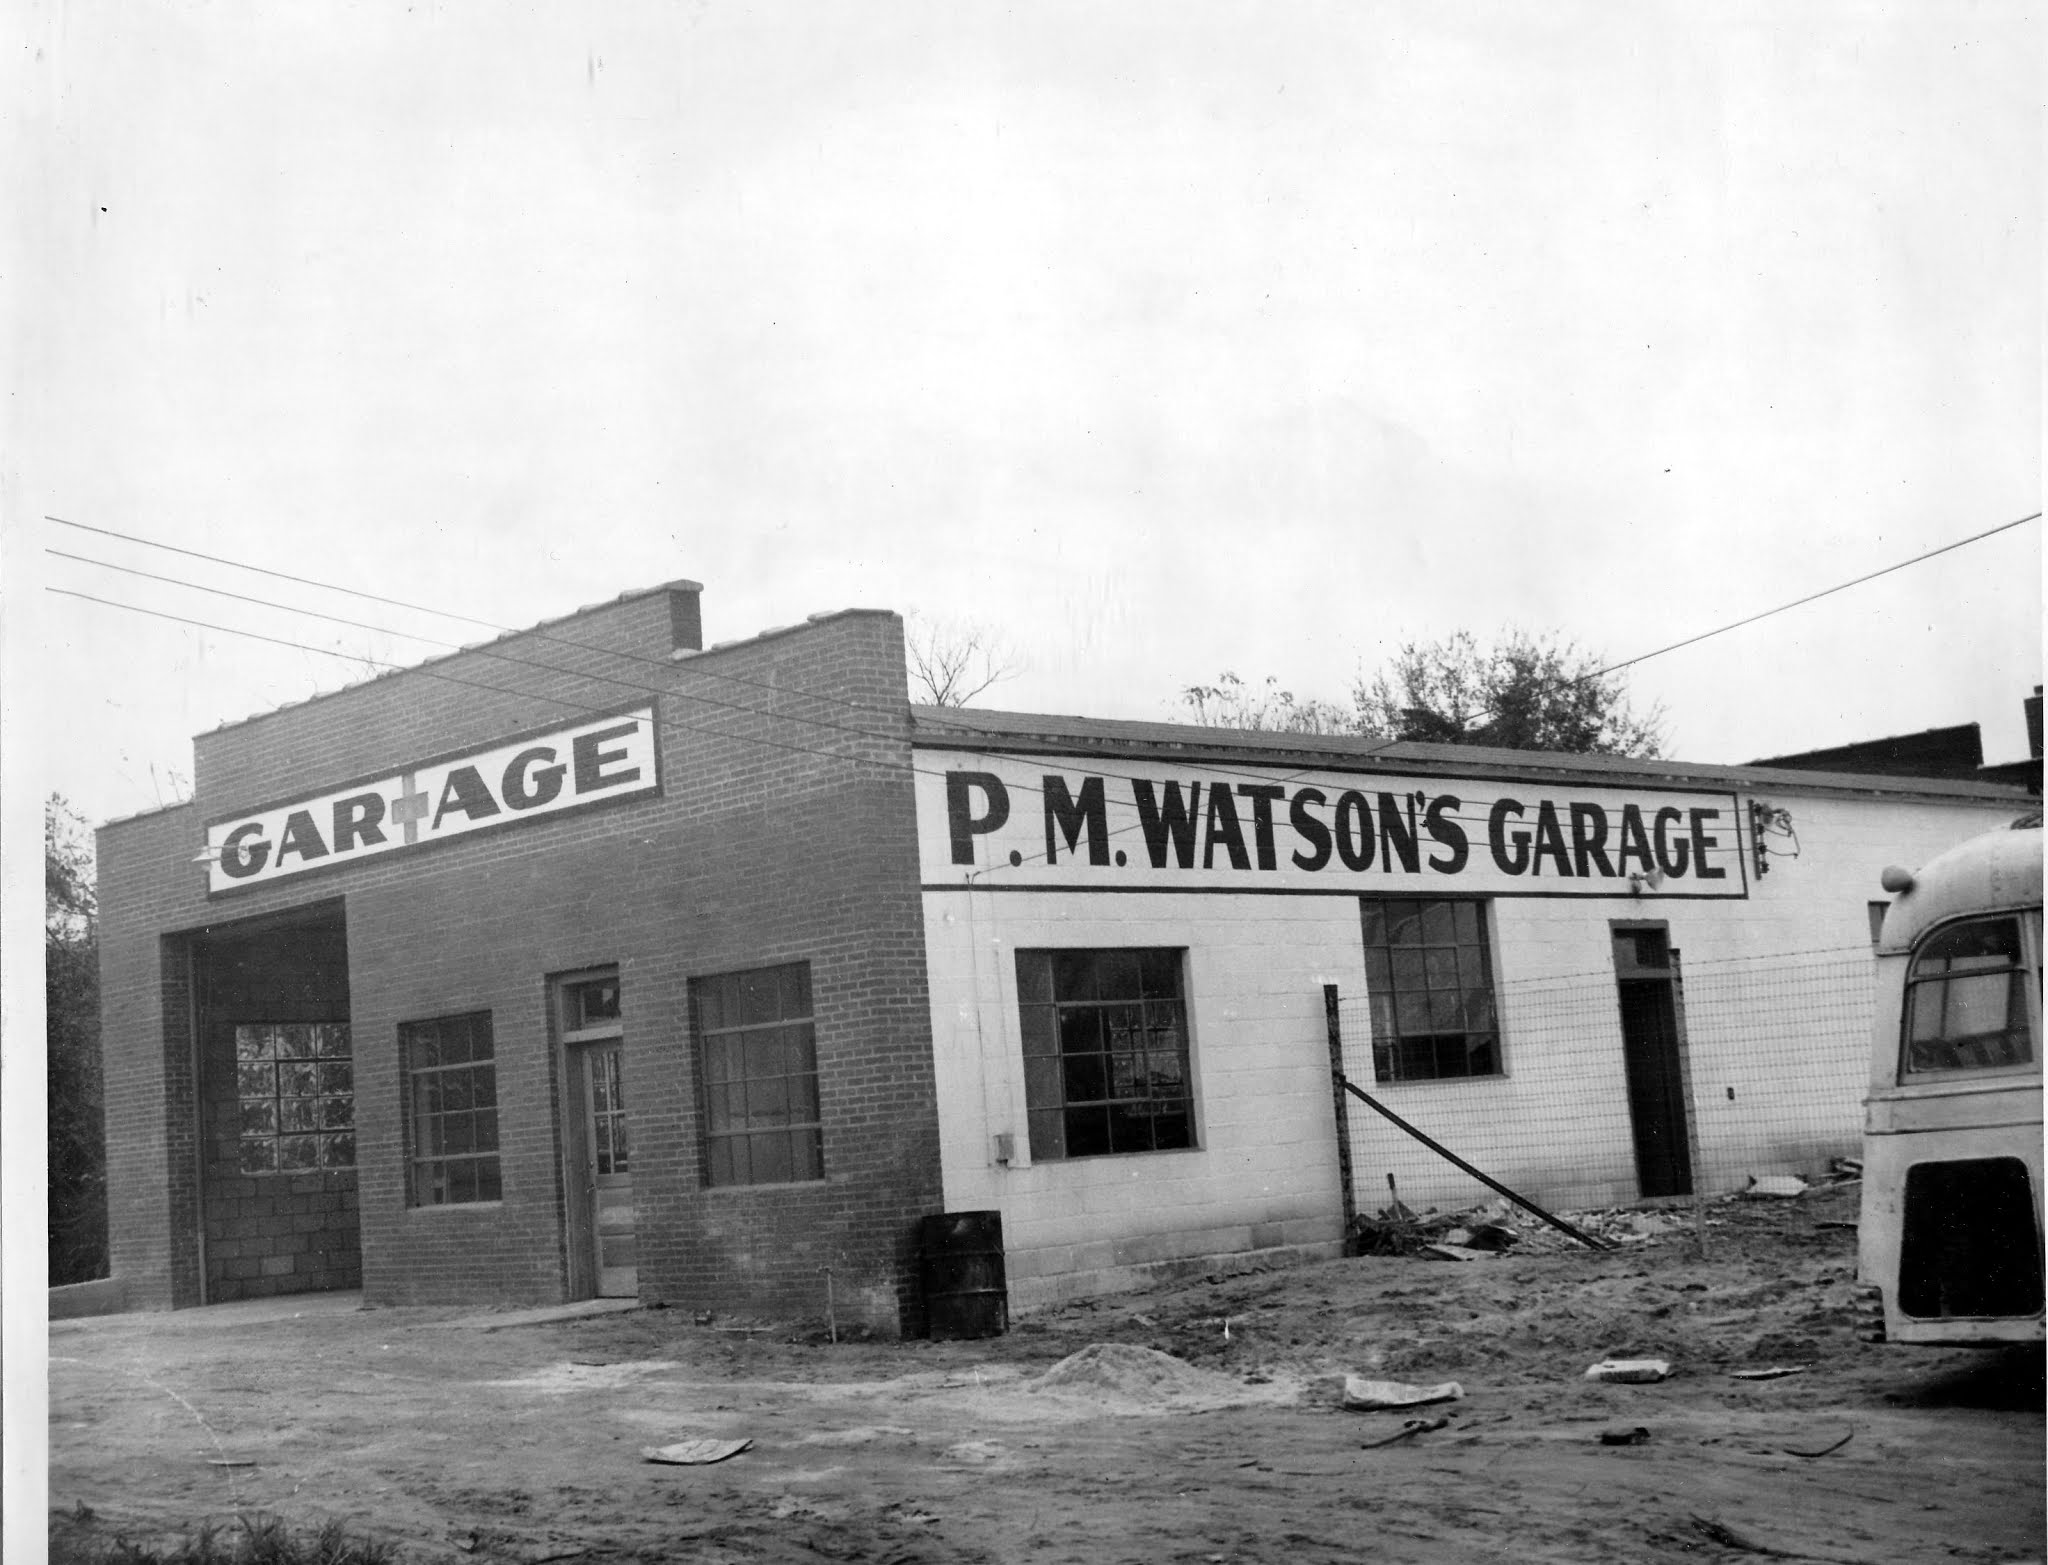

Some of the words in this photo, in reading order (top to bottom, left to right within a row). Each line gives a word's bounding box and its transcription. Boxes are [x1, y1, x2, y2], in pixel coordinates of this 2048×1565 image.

[220, 720, 641, 879] GARAGE
[1131, 779, 1470, 875] WATSON'S
[1488, 798, 1726, 880] GARAGE
